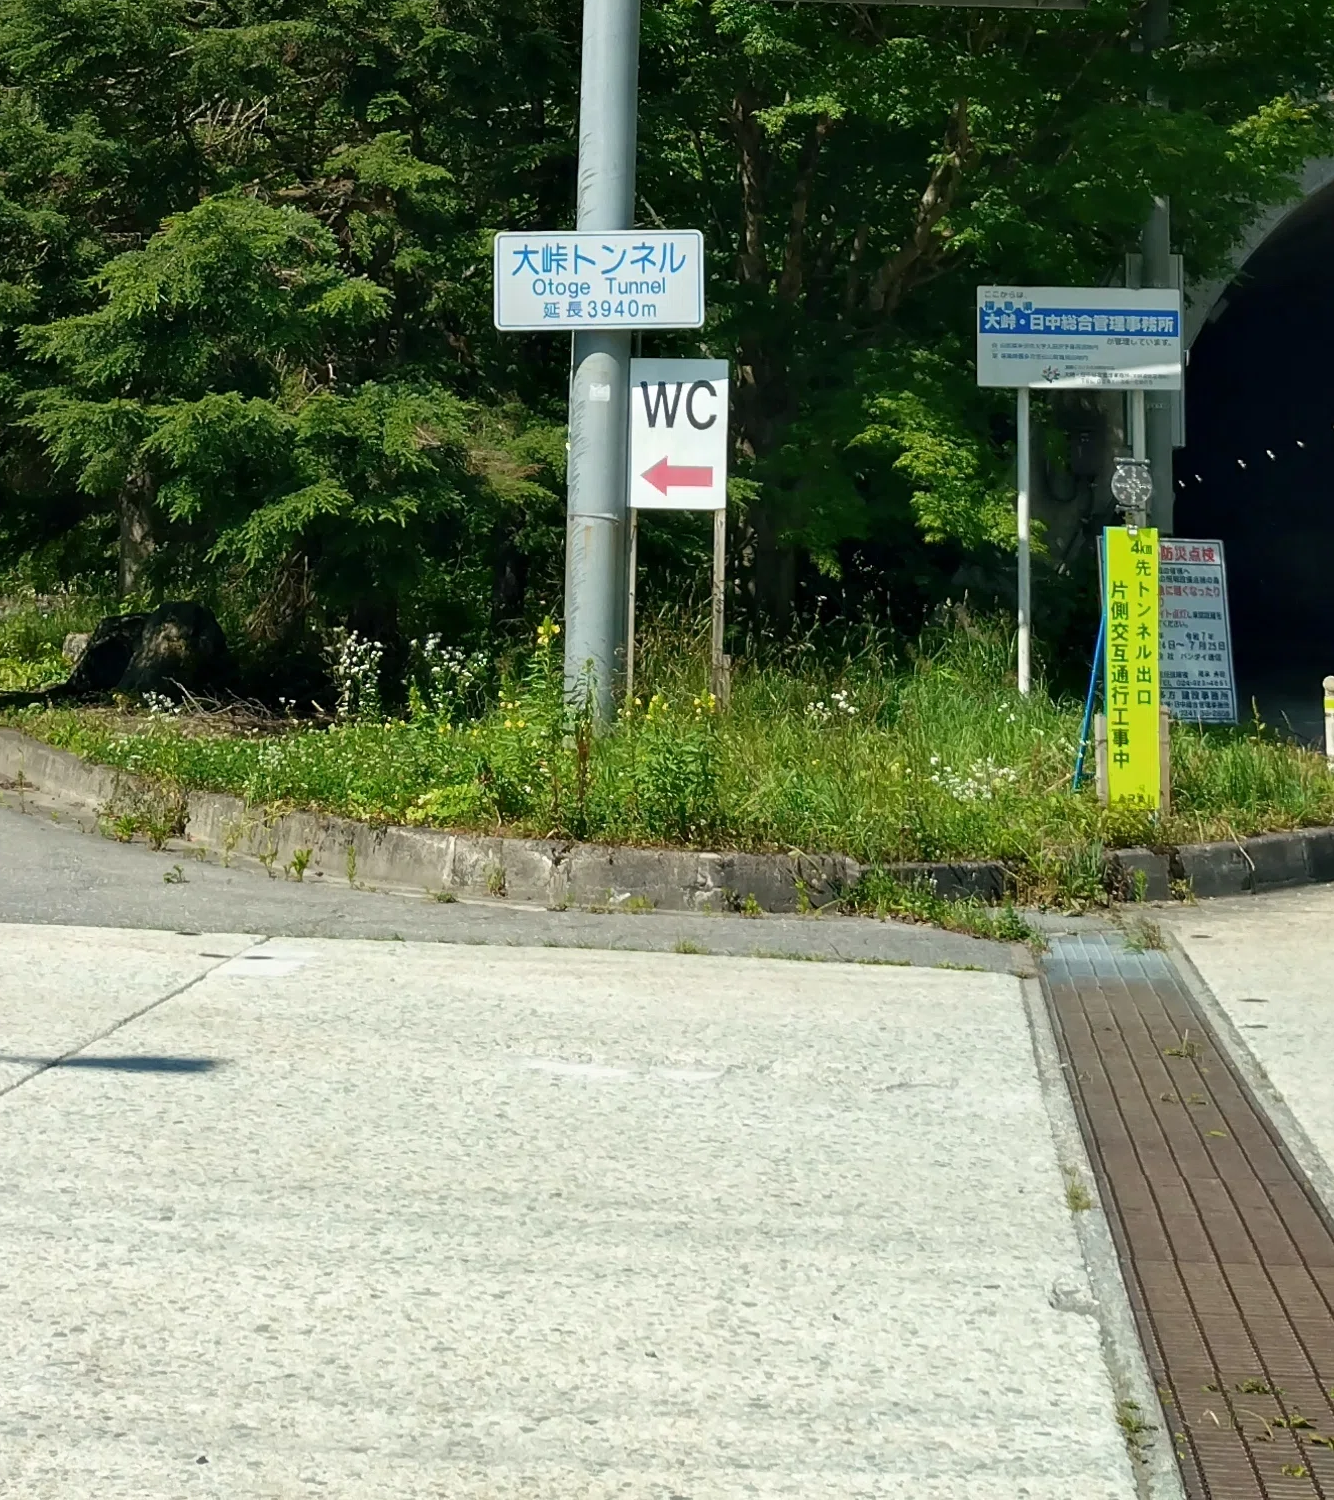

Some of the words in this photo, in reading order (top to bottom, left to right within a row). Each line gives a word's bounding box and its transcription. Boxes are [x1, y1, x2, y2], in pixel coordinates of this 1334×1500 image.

[512, 241, 686, 276] 大峠トンネル
[532, 278, 591, 298] Otoge
[605, 277, 666, 295] Tunnel
[543, 300, 657, 318] 延長3940m
[984, 314, 1174, 333] 大峠・日中総合管理事務所
[640, 380, 717, 430] WC
[1111, 580, 1130, 769] 片側交互通行工事中
